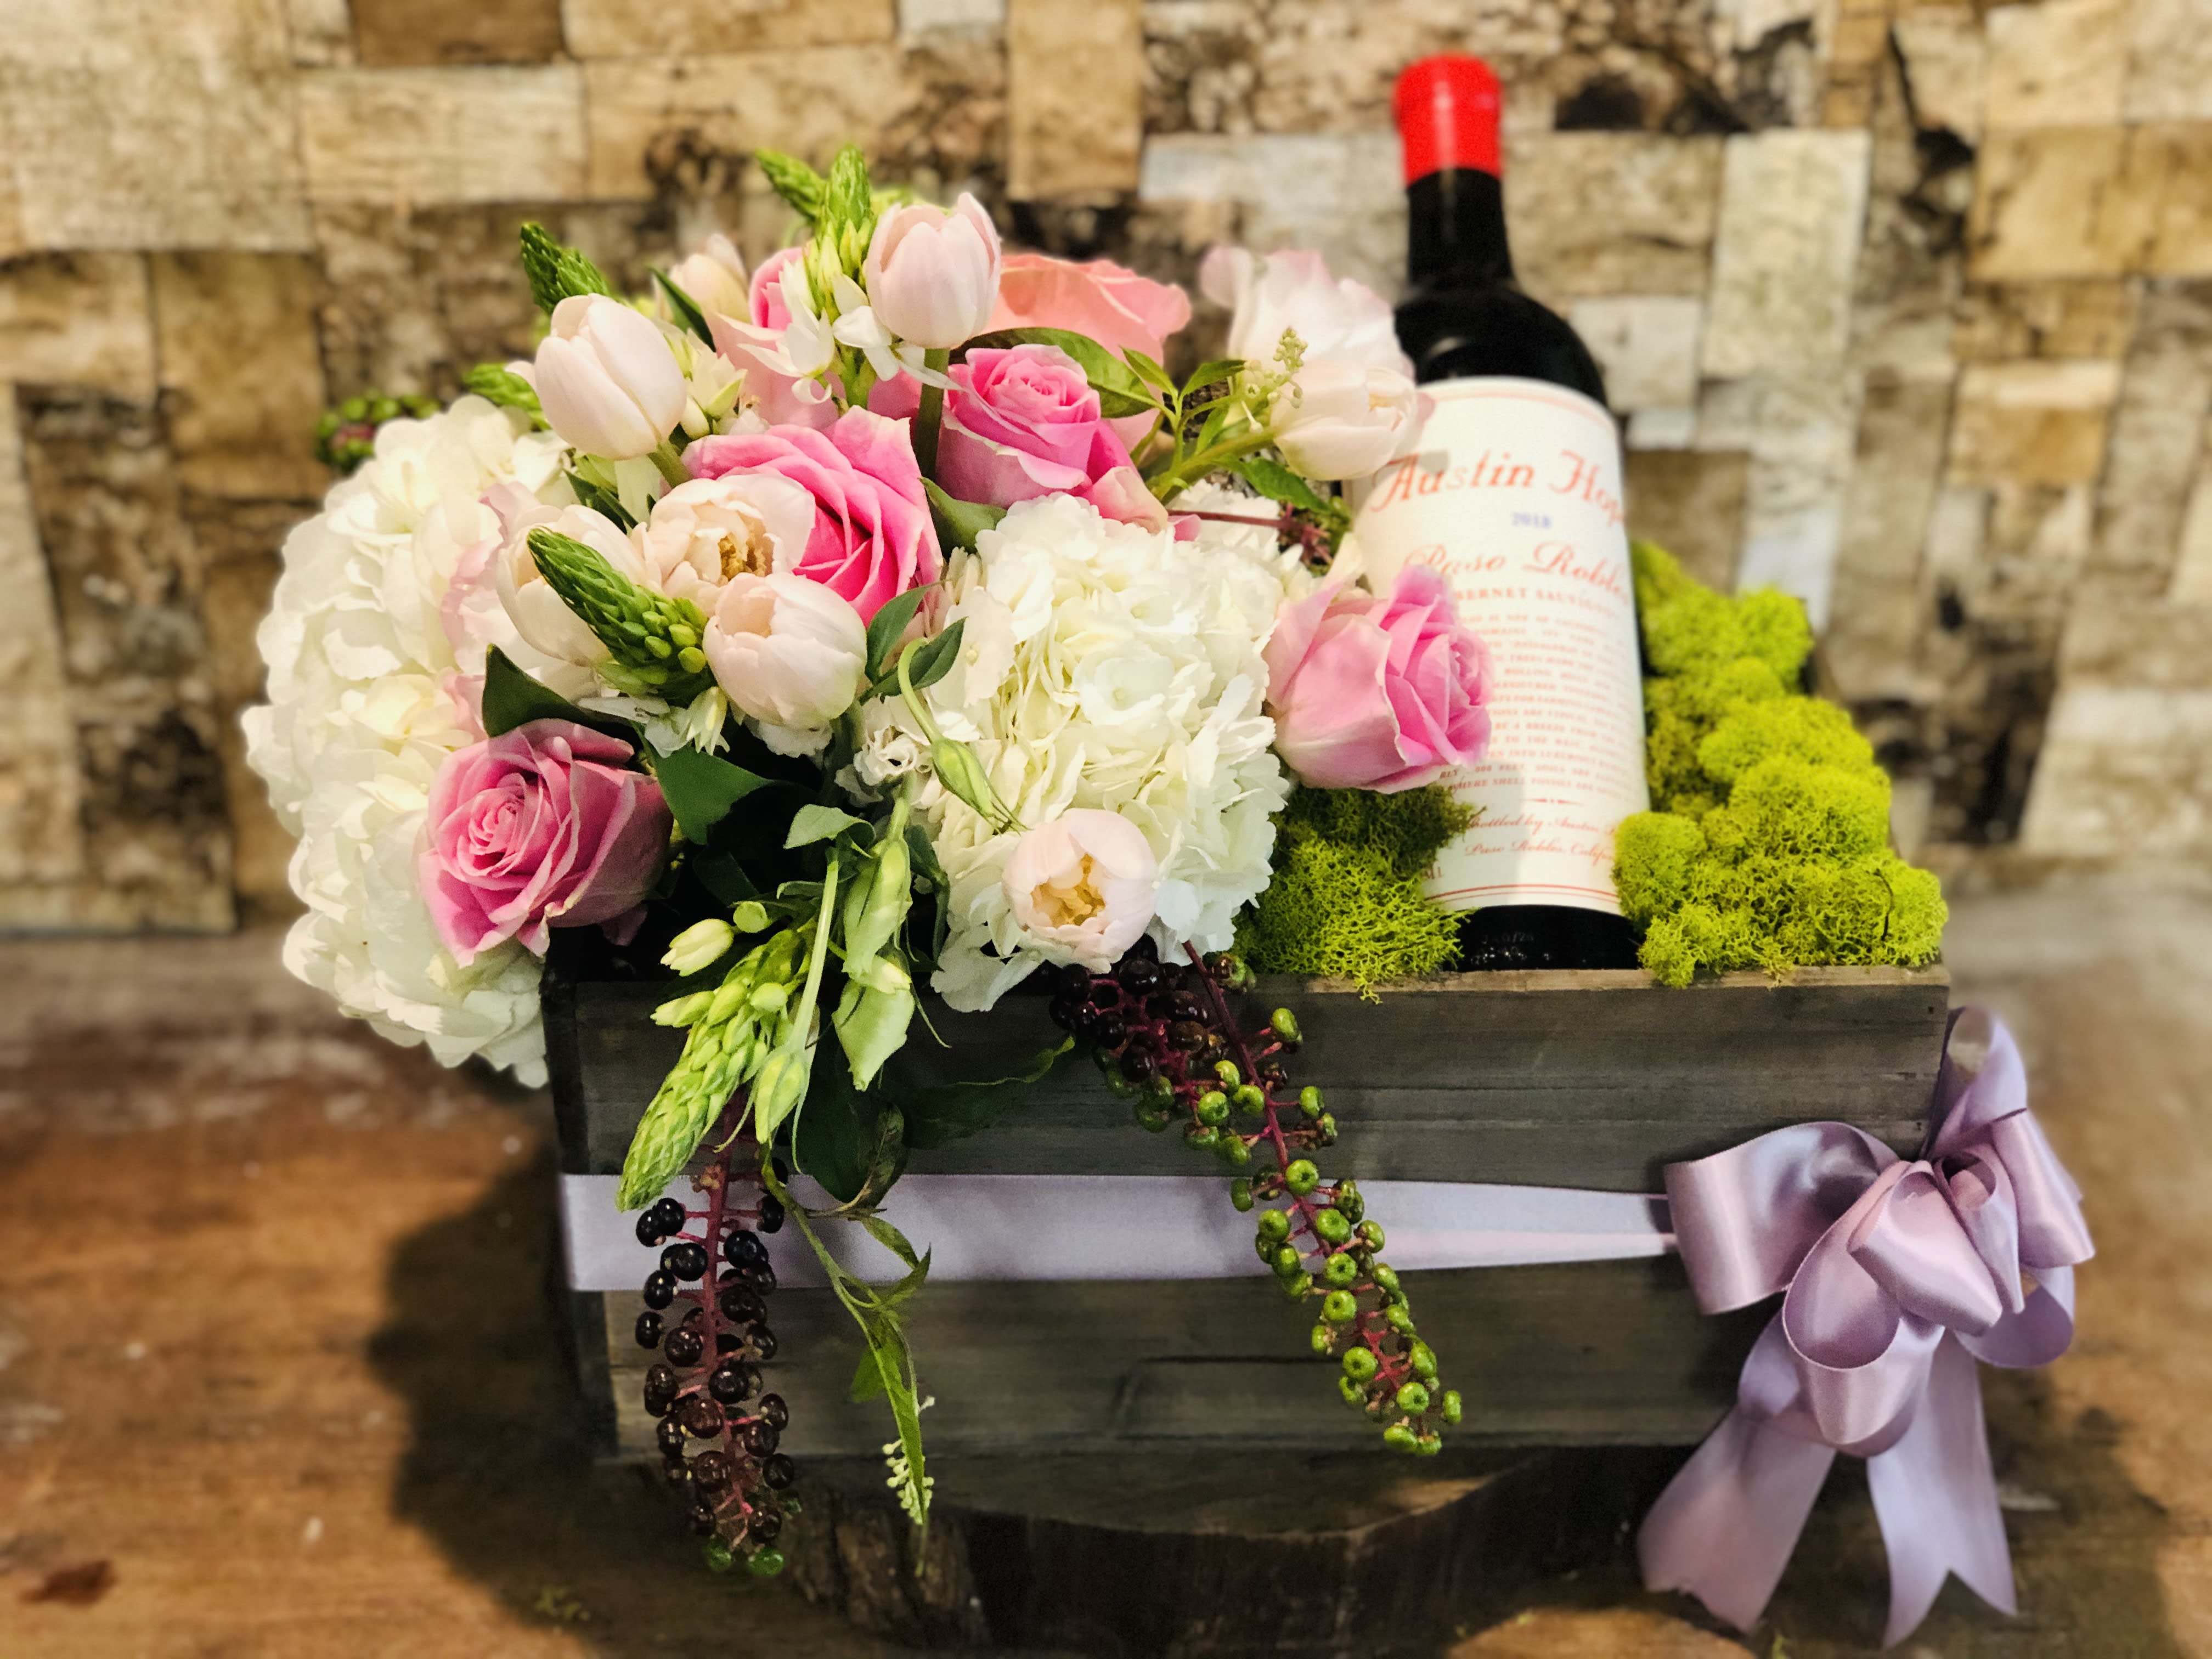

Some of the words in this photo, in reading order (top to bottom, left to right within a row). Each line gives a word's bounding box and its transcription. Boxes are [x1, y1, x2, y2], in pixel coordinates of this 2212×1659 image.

[1370, 449, 1534, 512] Austin
[1548, 449, 1624, 529] Hop
[1404, 542, 1508, 576] Paso
[1454, 588, 1526, 601] BERNET
